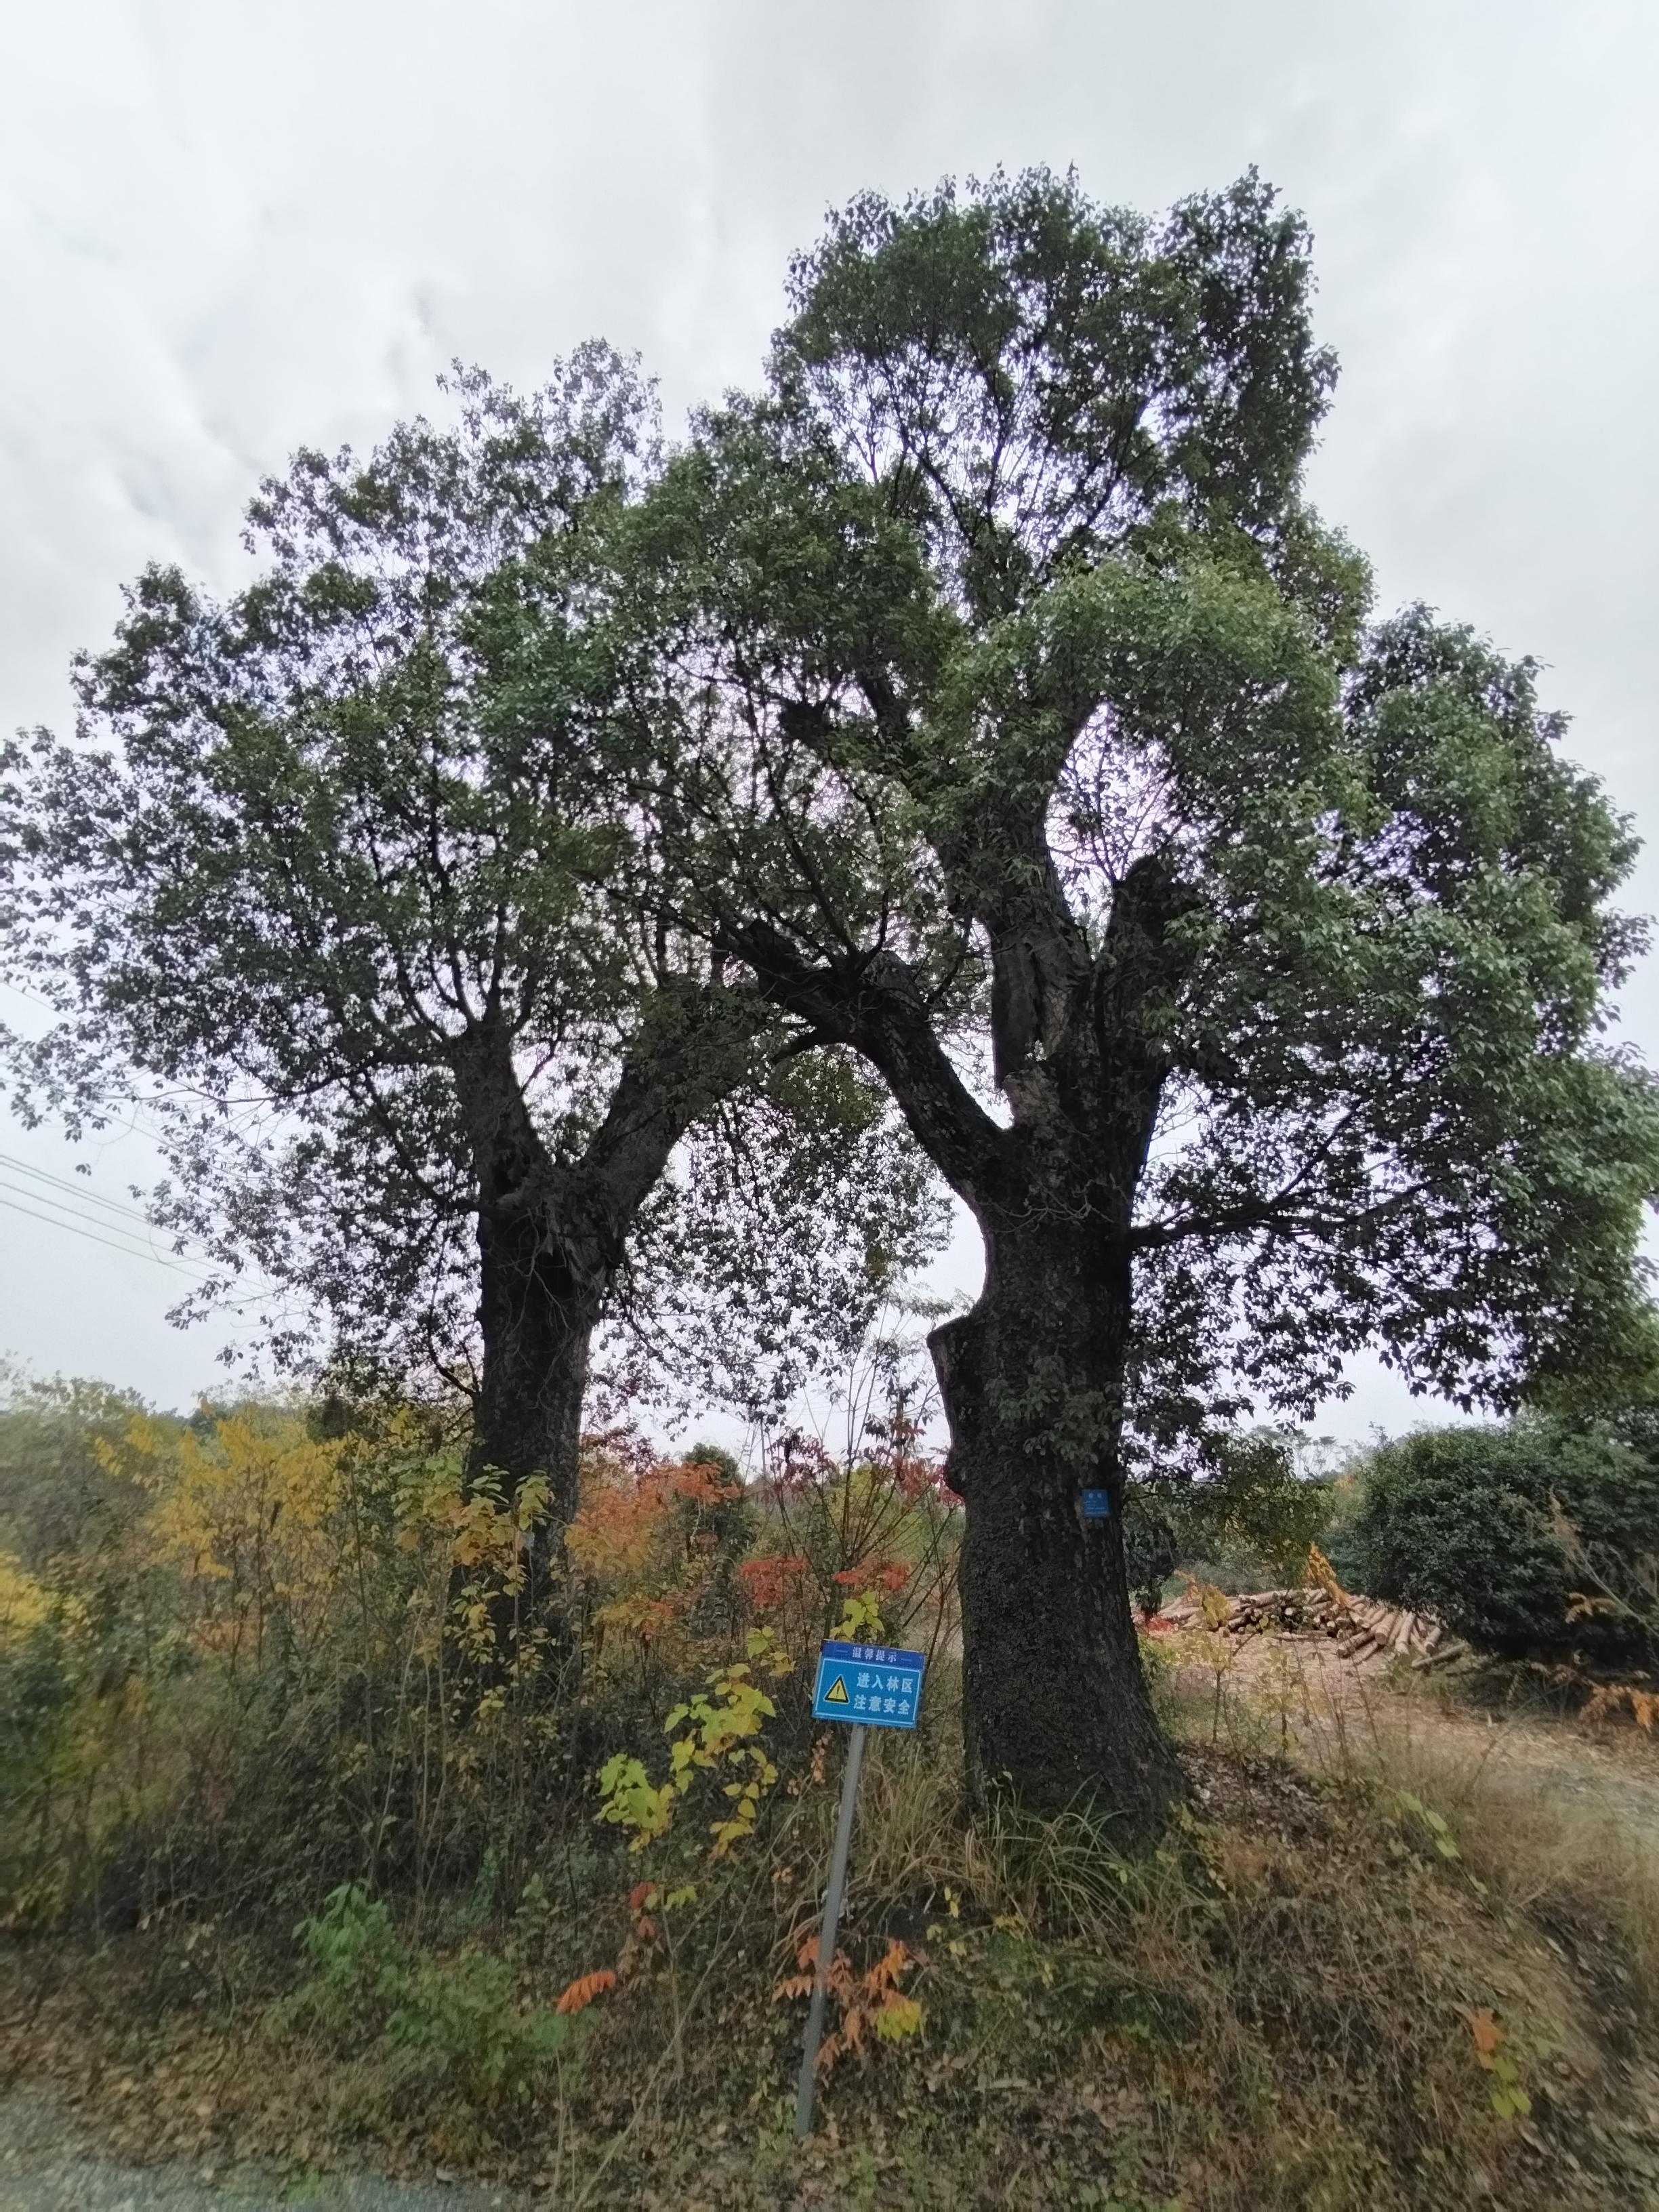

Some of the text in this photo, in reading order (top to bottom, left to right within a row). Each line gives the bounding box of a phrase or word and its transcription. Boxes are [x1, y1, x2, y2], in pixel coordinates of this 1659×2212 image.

[852, 1647, 897, 1663] 温馨提示
[856, 1672, 914, 1693] 进入林区
[853, 1694, 910, 1715] 注意安全
